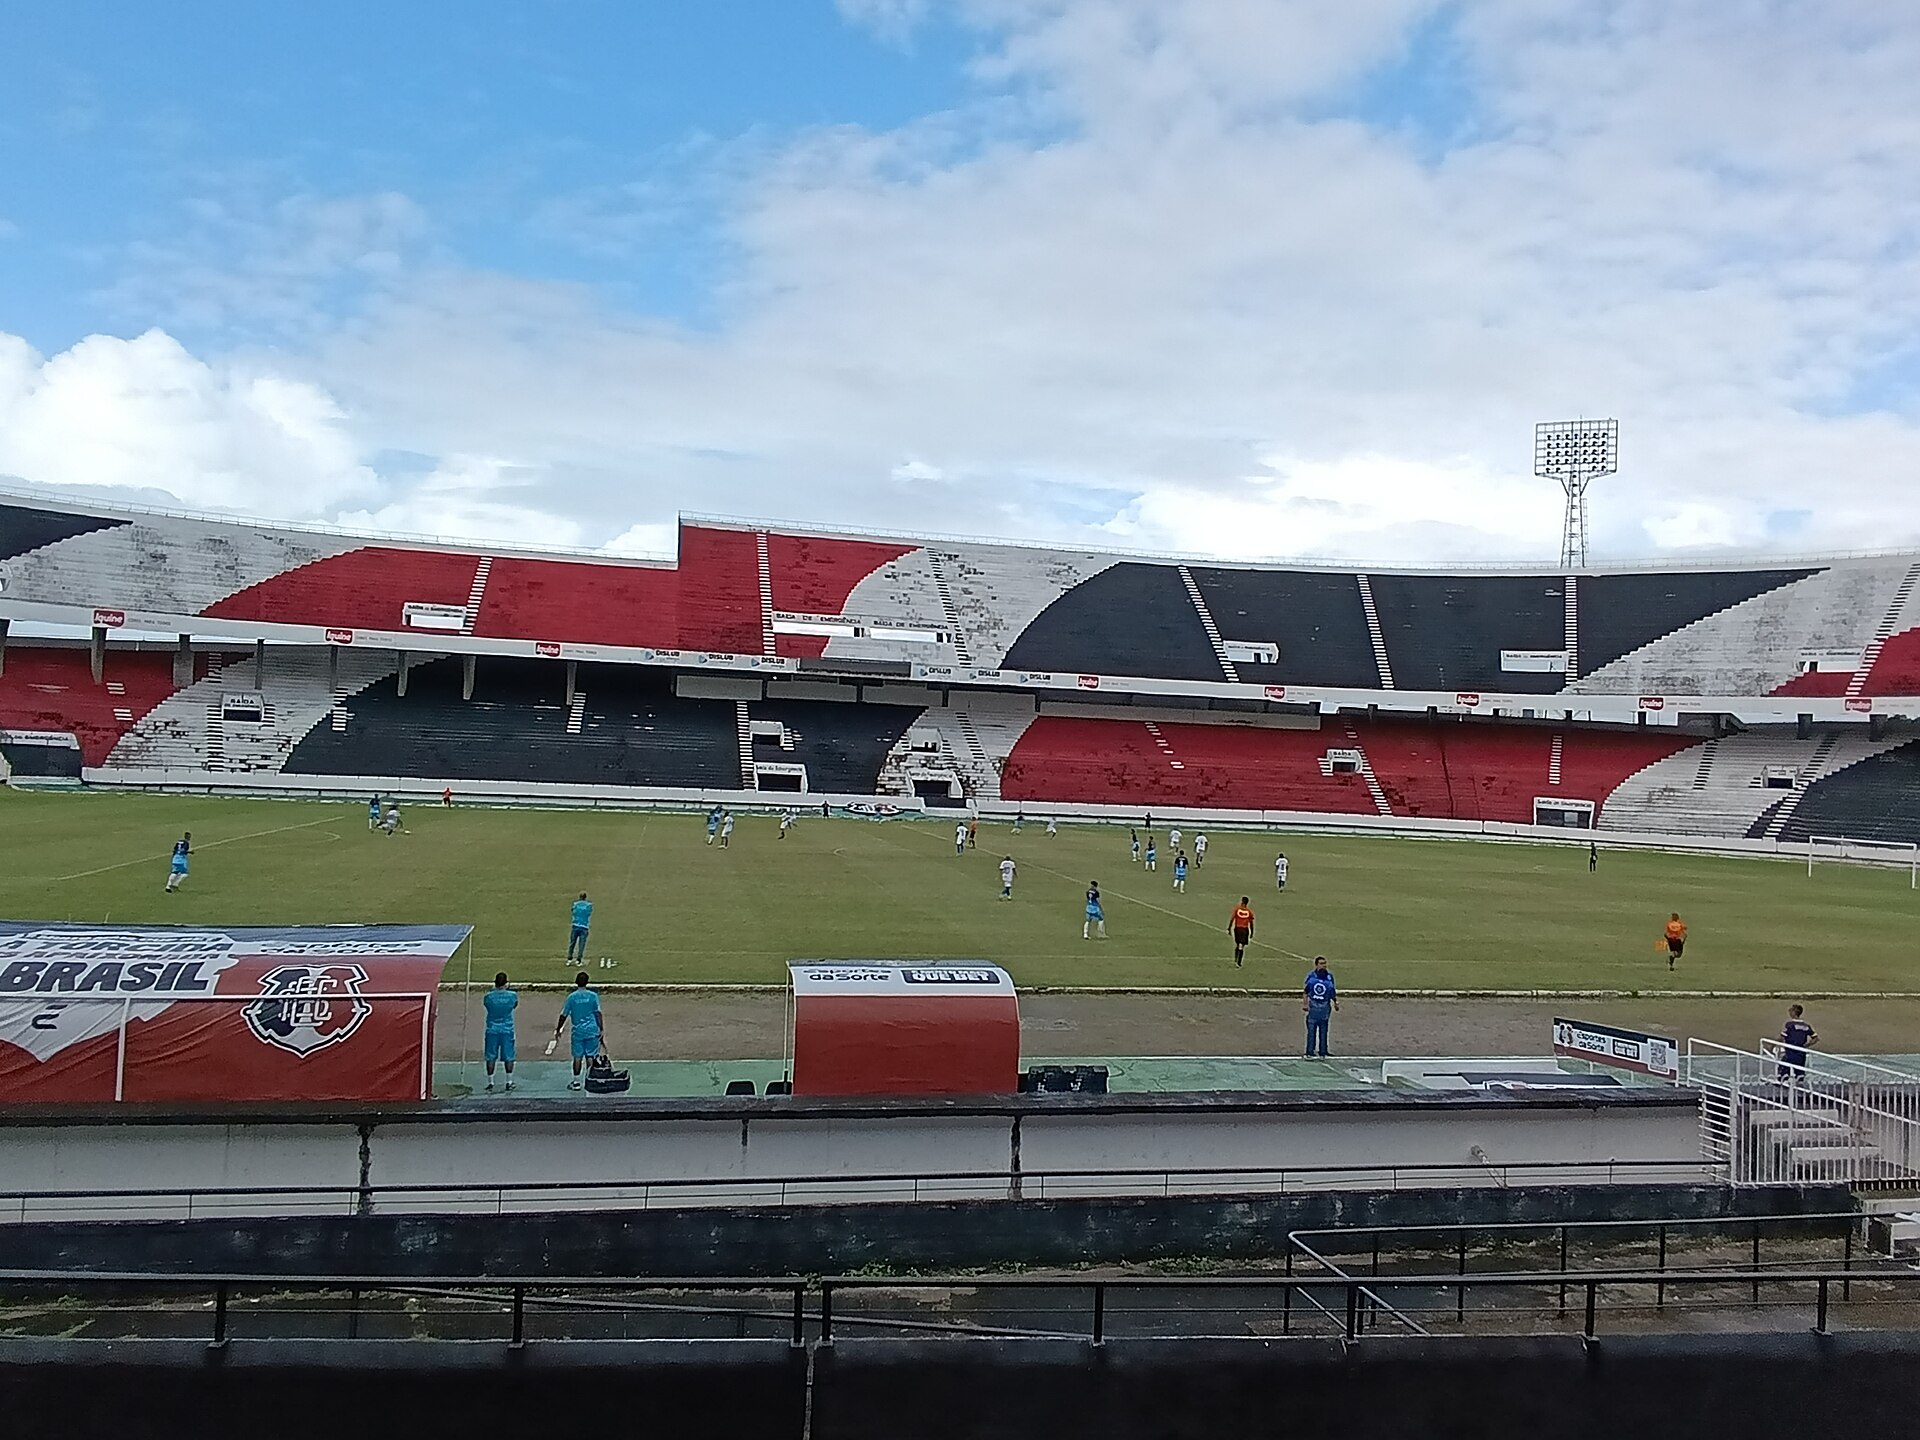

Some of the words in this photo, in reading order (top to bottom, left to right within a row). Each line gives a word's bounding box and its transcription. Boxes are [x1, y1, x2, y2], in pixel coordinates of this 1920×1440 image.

[94, 612, 123, 625] Iquine
[36, 941, 234, 952] TORCIDA
[0, 961, 209, 992] BRASIL
